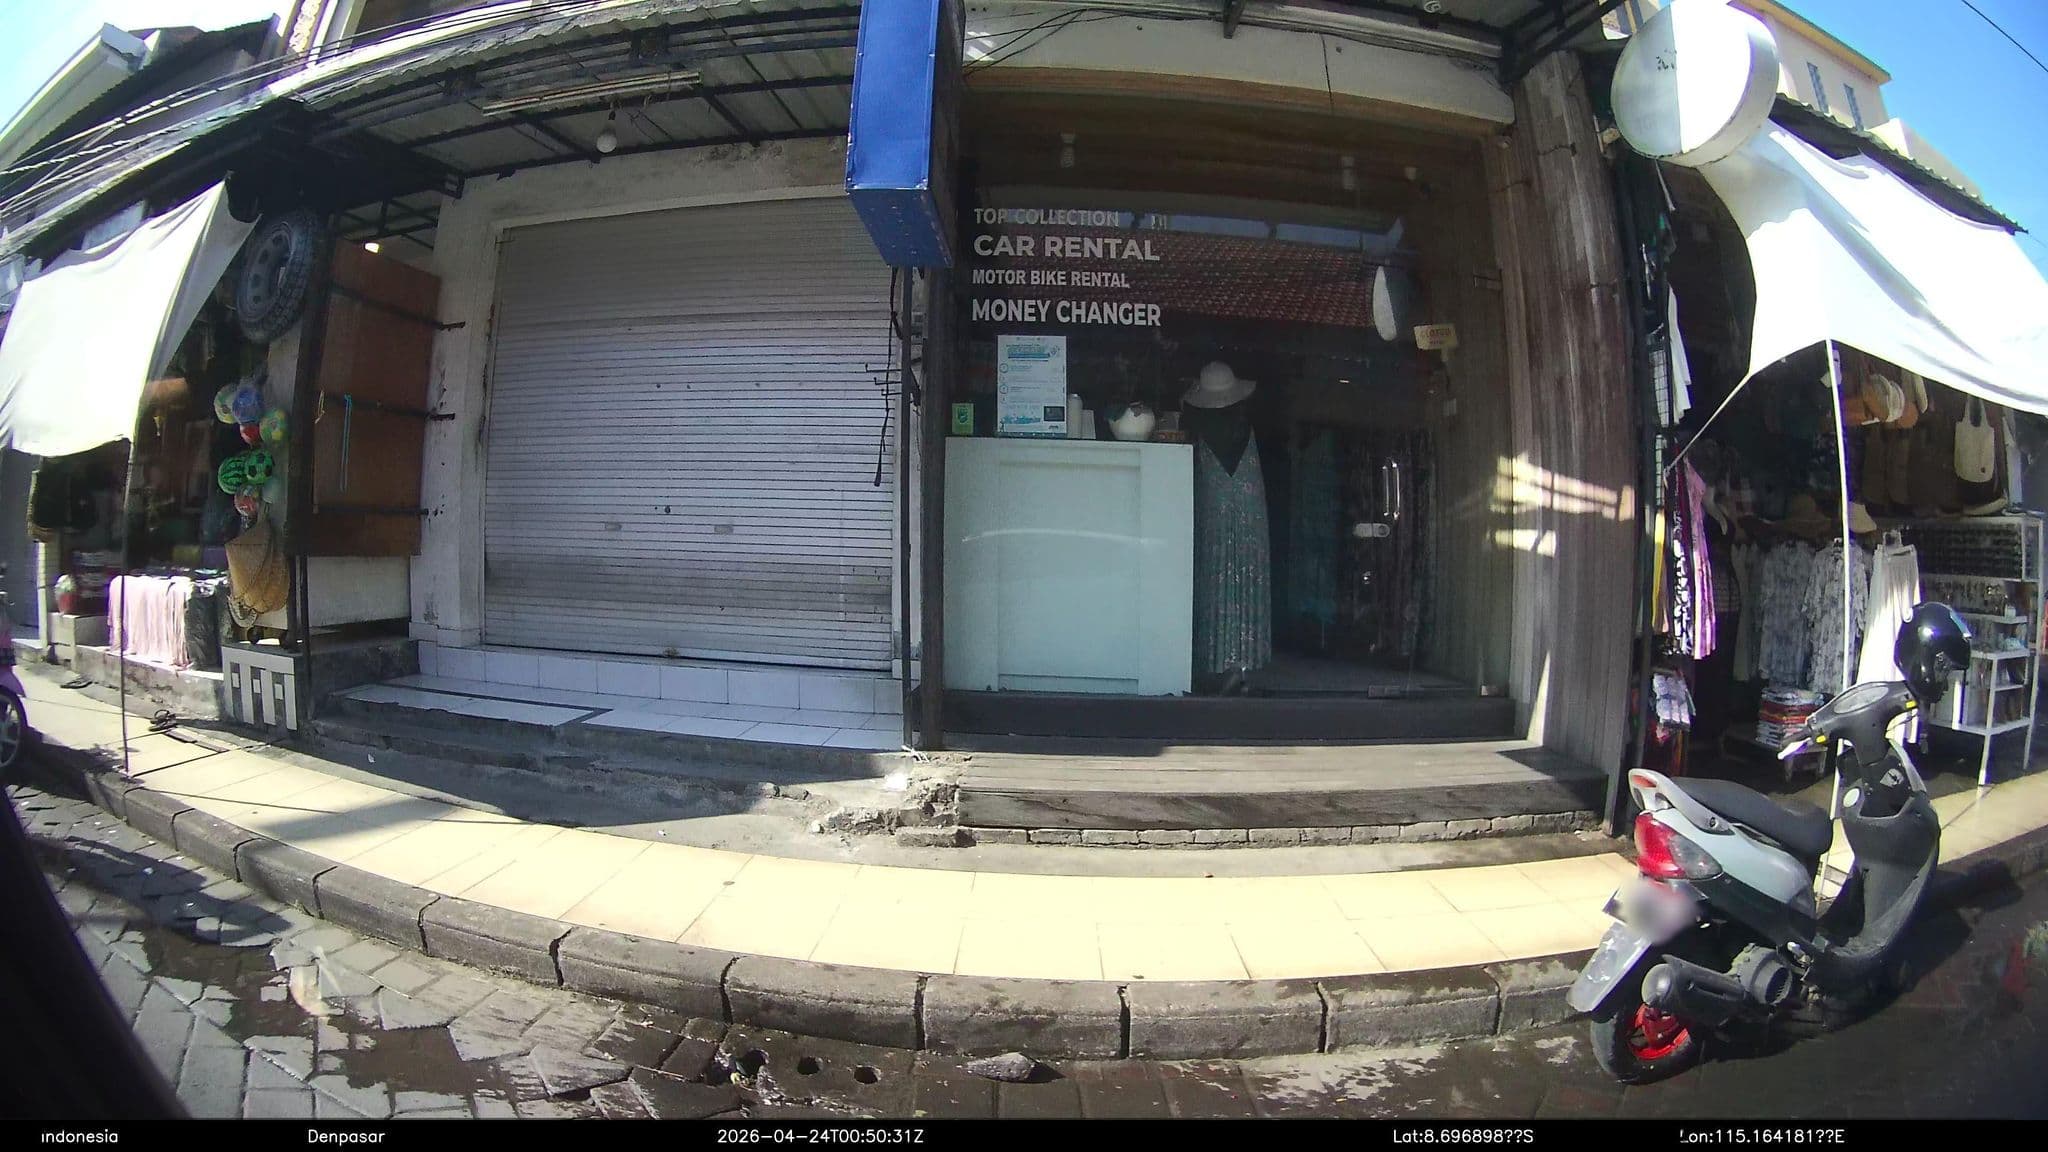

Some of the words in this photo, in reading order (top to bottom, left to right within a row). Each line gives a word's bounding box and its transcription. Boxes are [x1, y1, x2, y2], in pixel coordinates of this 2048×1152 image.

[974, 208, 1009, 225] TOP
[1015, 208, 1119, 227] COLLECTION
[973, 235, 1035, 257] CAR
[1045, 236, 1160, 261] RENTAL
[972, 269, 1026, 285] MOTOR
[1030, 270, 1067, 286] BIKE
[1071, 271, 1130, 289] RENTAL
[971, 298, 1051, 323] MONEY
[1056, 300, 1161, 327] CHANGER
